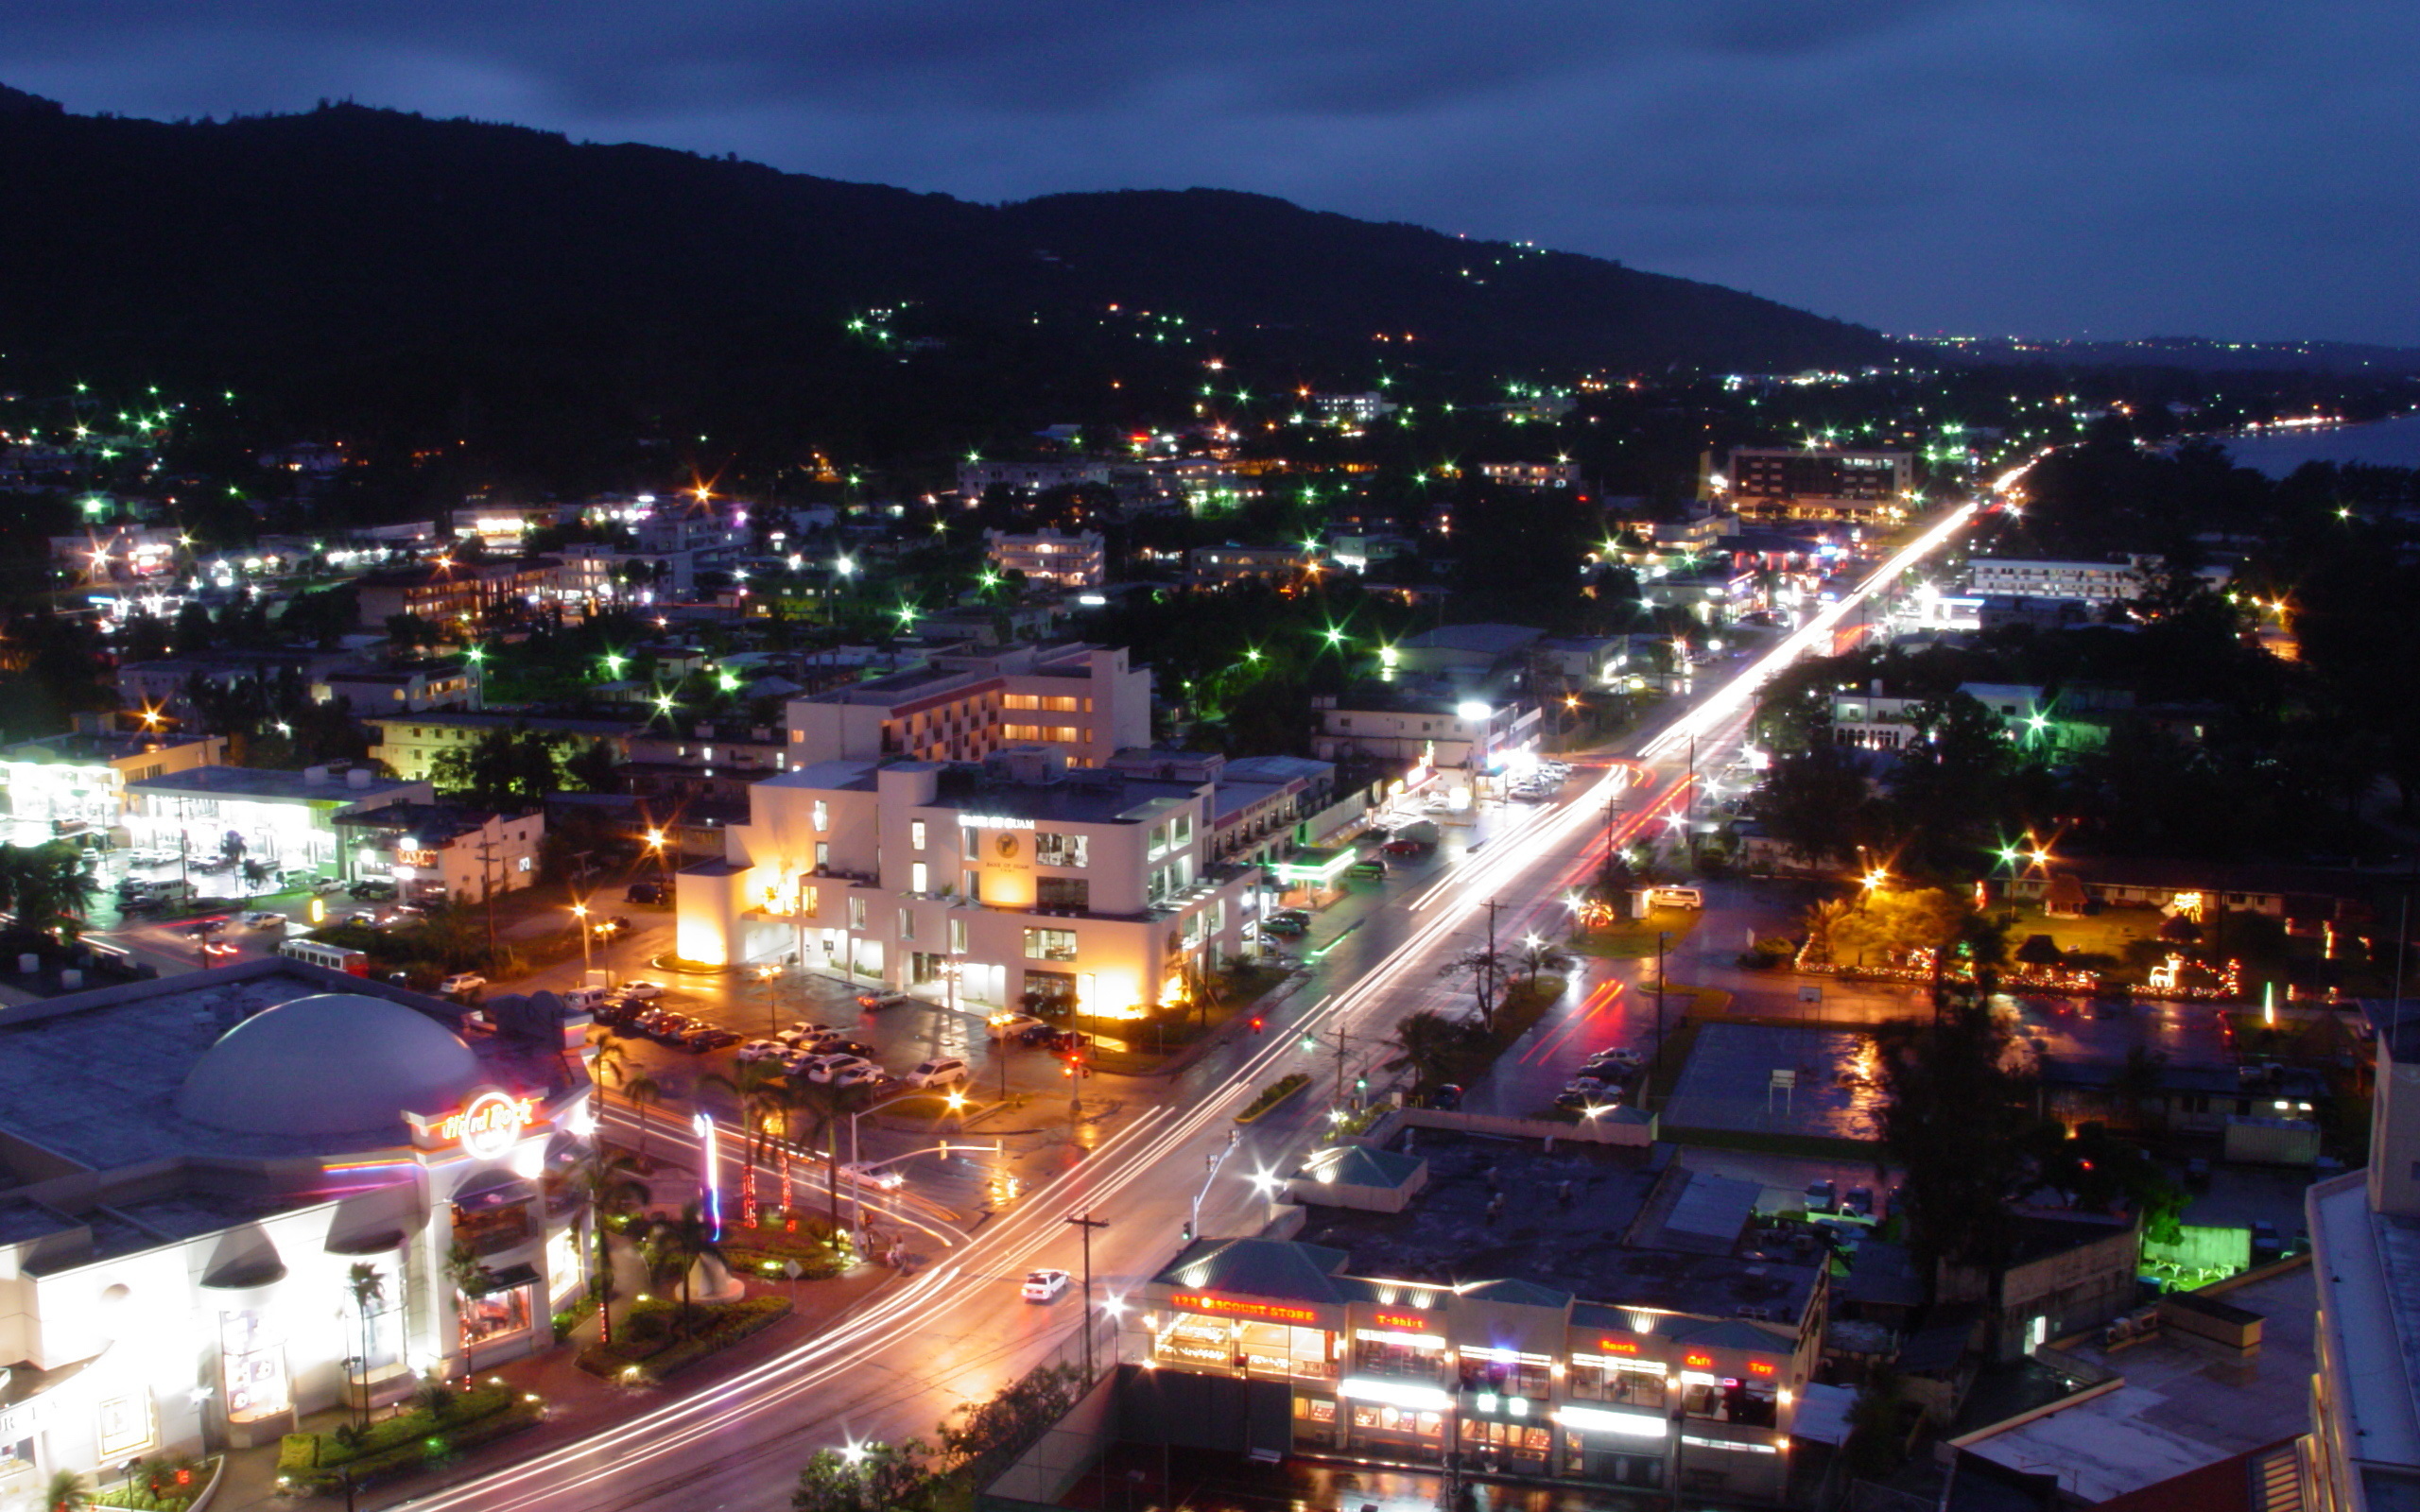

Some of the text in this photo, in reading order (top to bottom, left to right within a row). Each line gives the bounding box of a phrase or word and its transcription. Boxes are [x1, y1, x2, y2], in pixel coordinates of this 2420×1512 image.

[1004, 817, 1035, 830] GUAM
[441, 1108, 491, 1141] Hard
[489, 1097, 532, 1129] Rock
[1173, 1295, 1199, 1307] 123
[1270, 1306, 1315, 1321] STORE
[1376, 1314, 1424, 1329] T-Shirt
[1601, 1339, 1636, 1353] Snack
[1686, 1355, 1712, 1366] Gift
[1750, 1362, 1773, 1375] Toy
